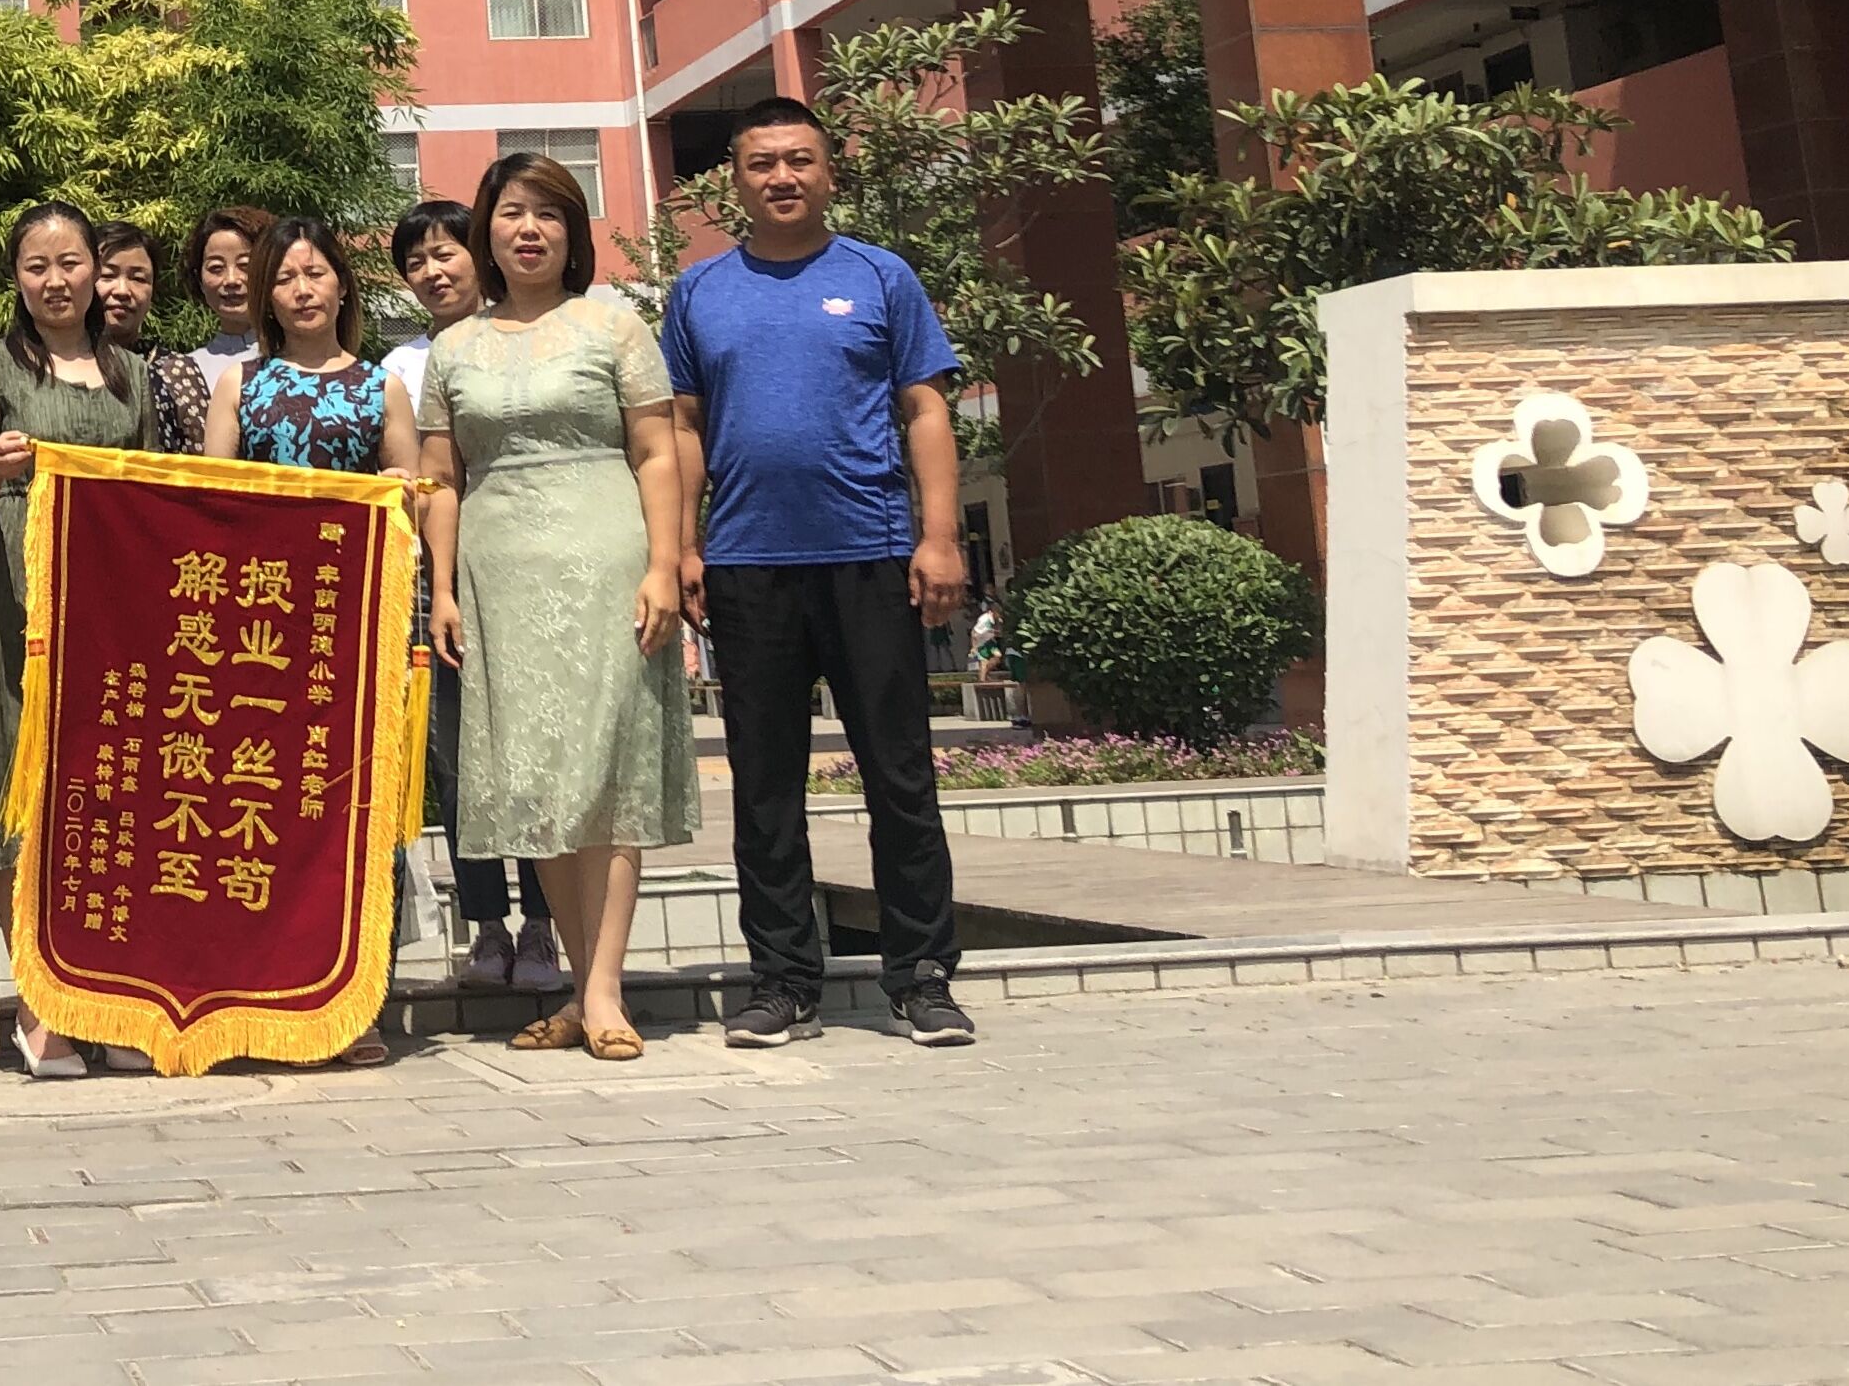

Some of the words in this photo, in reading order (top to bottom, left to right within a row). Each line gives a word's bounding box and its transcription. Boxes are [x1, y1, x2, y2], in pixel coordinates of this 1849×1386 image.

[151, 550, 230, 901] 解惑无微不至
[216, 556, 295, 911] 授业一丝不苟
